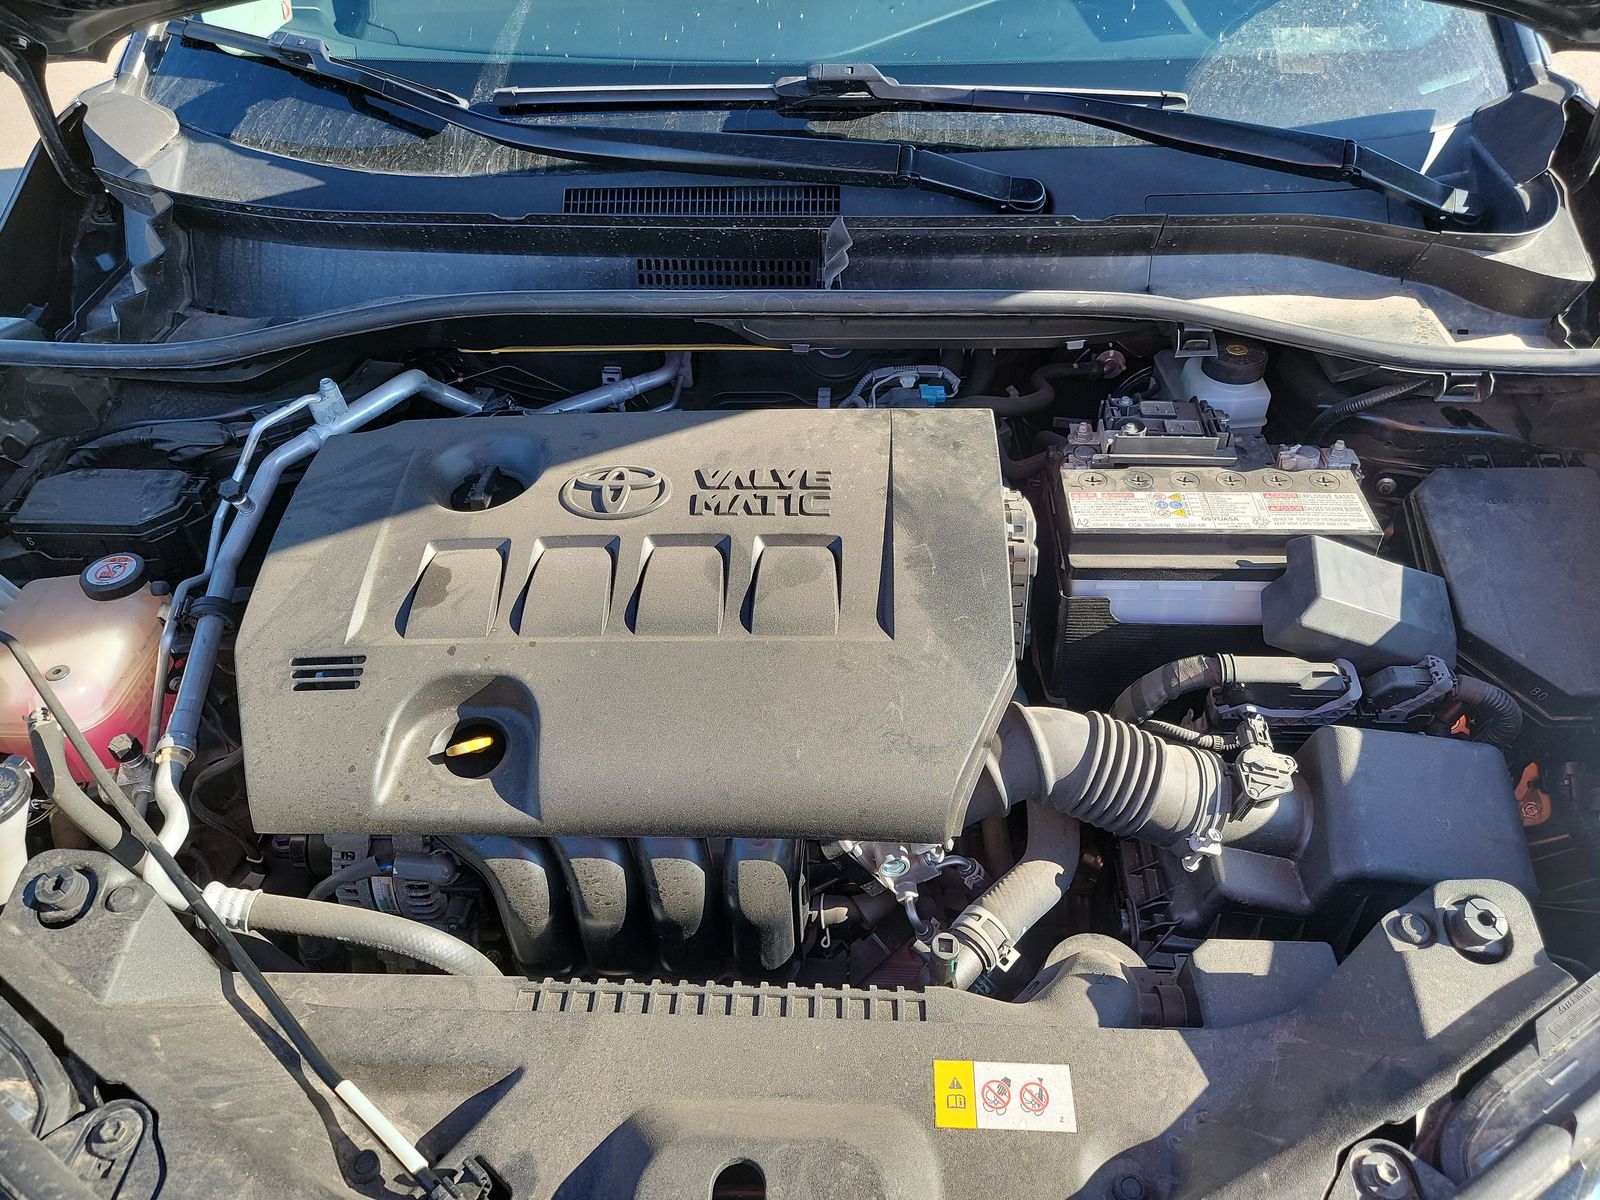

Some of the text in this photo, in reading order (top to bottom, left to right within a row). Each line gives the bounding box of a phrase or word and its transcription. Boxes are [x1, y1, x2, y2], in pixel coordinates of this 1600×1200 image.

[694, 468, 832, 490] VALVE
[688, 492, 832, 517] MATIC
[1076, 519, 1089, 528] A2
